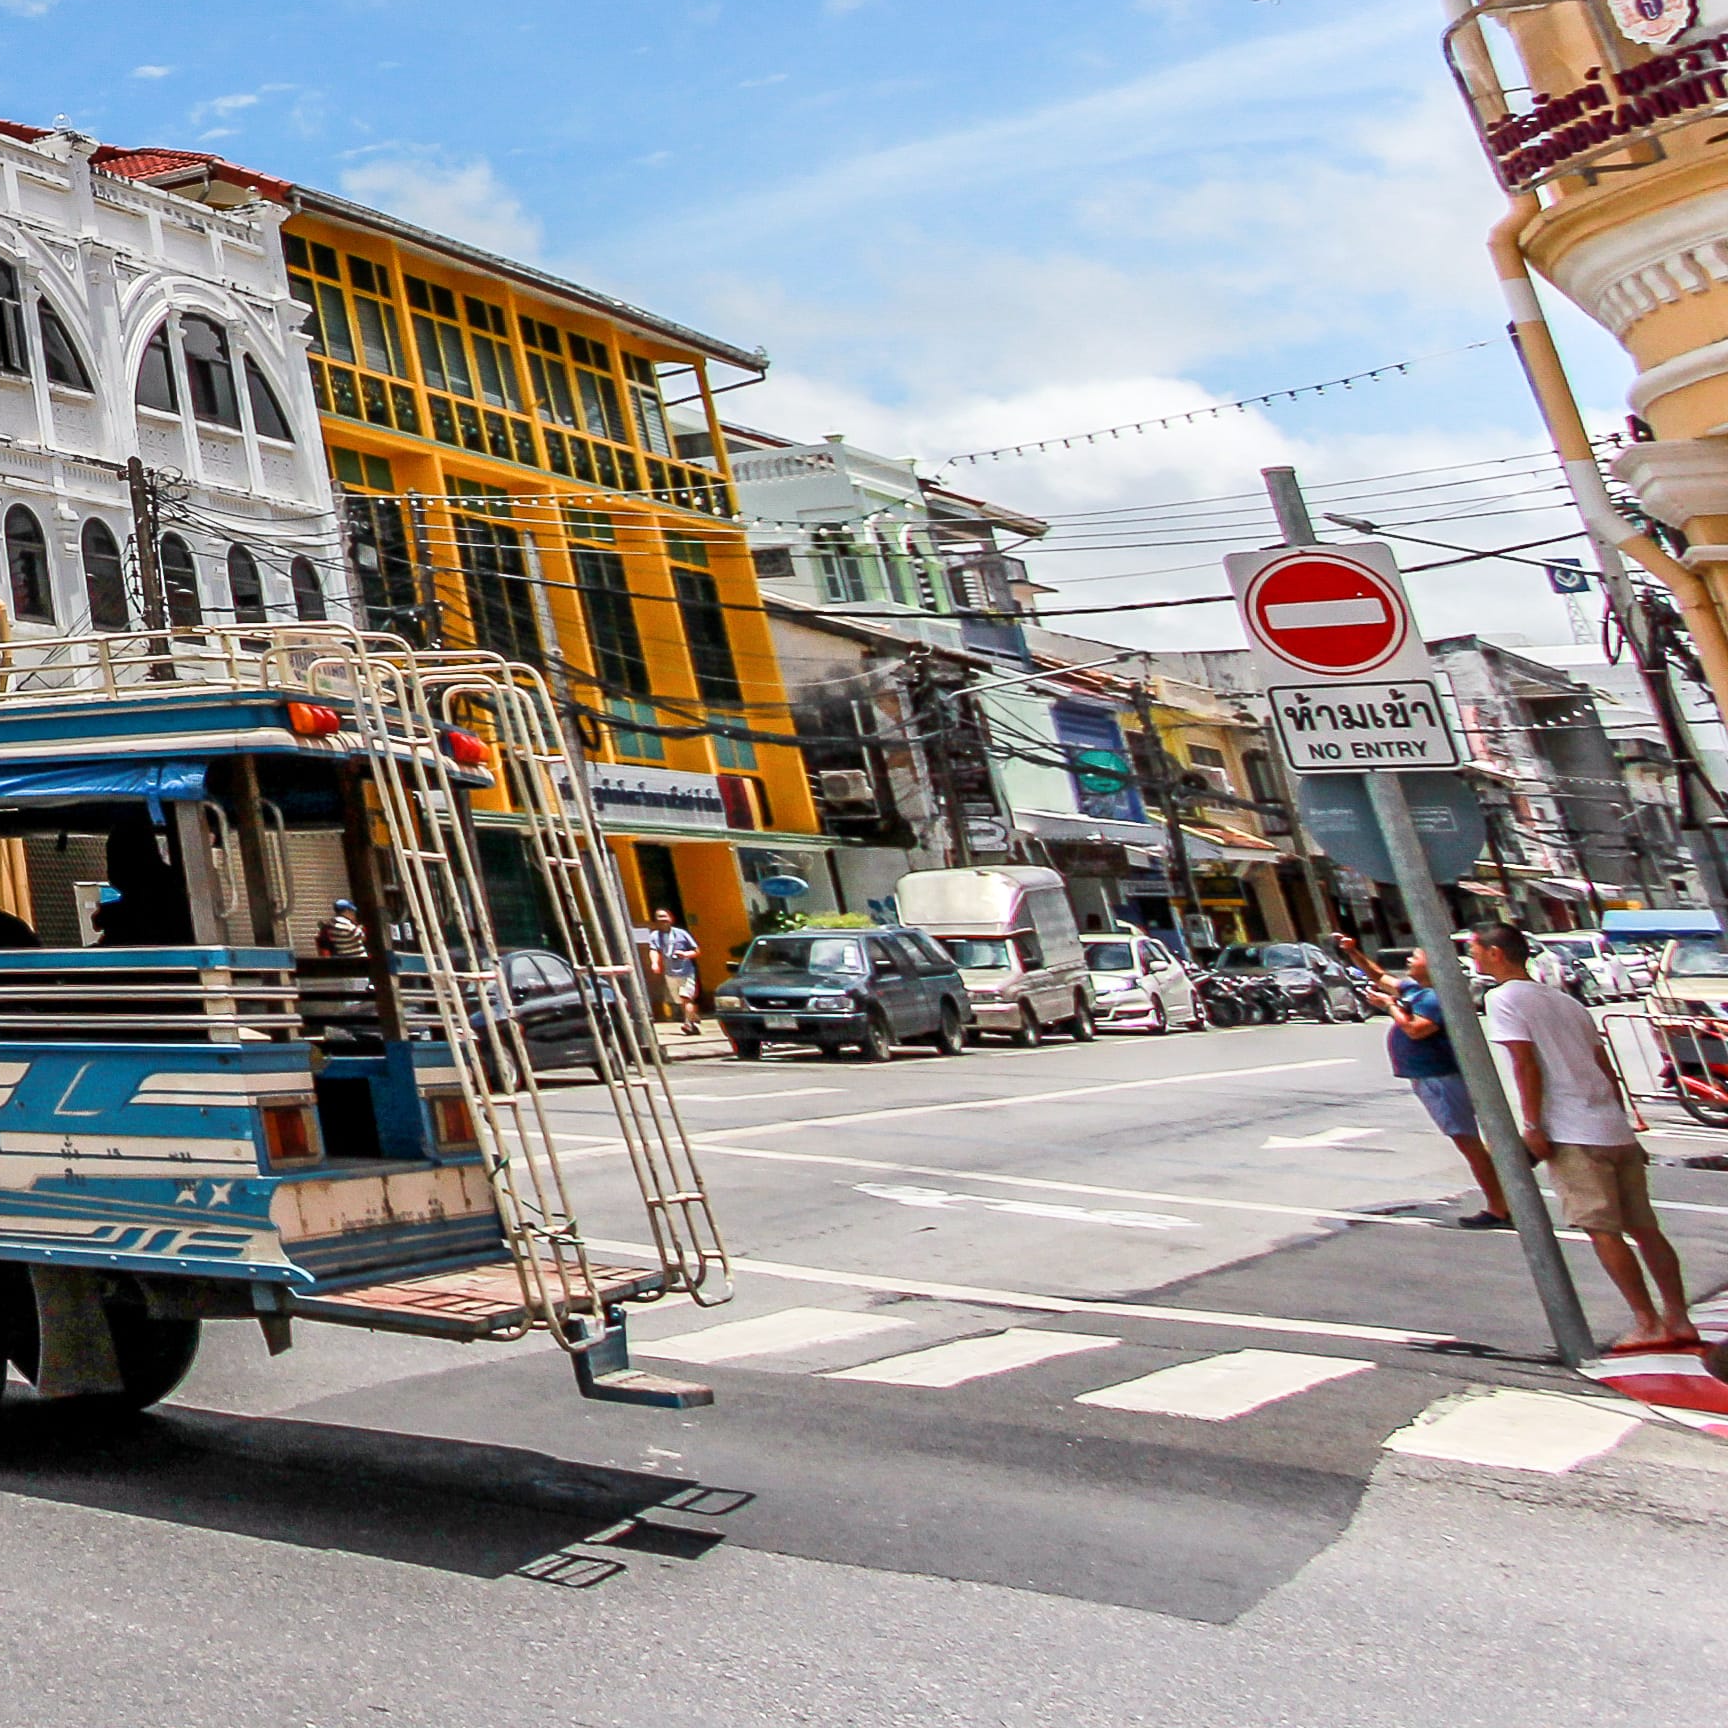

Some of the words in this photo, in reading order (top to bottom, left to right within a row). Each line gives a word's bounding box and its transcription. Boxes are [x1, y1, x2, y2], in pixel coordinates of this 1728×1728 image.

[1283, 688, 1437, 731] ห้ามเข้า
[1308, 742, 1342, 760] NO
[1350, 740, 1427, 759] ENTRY
